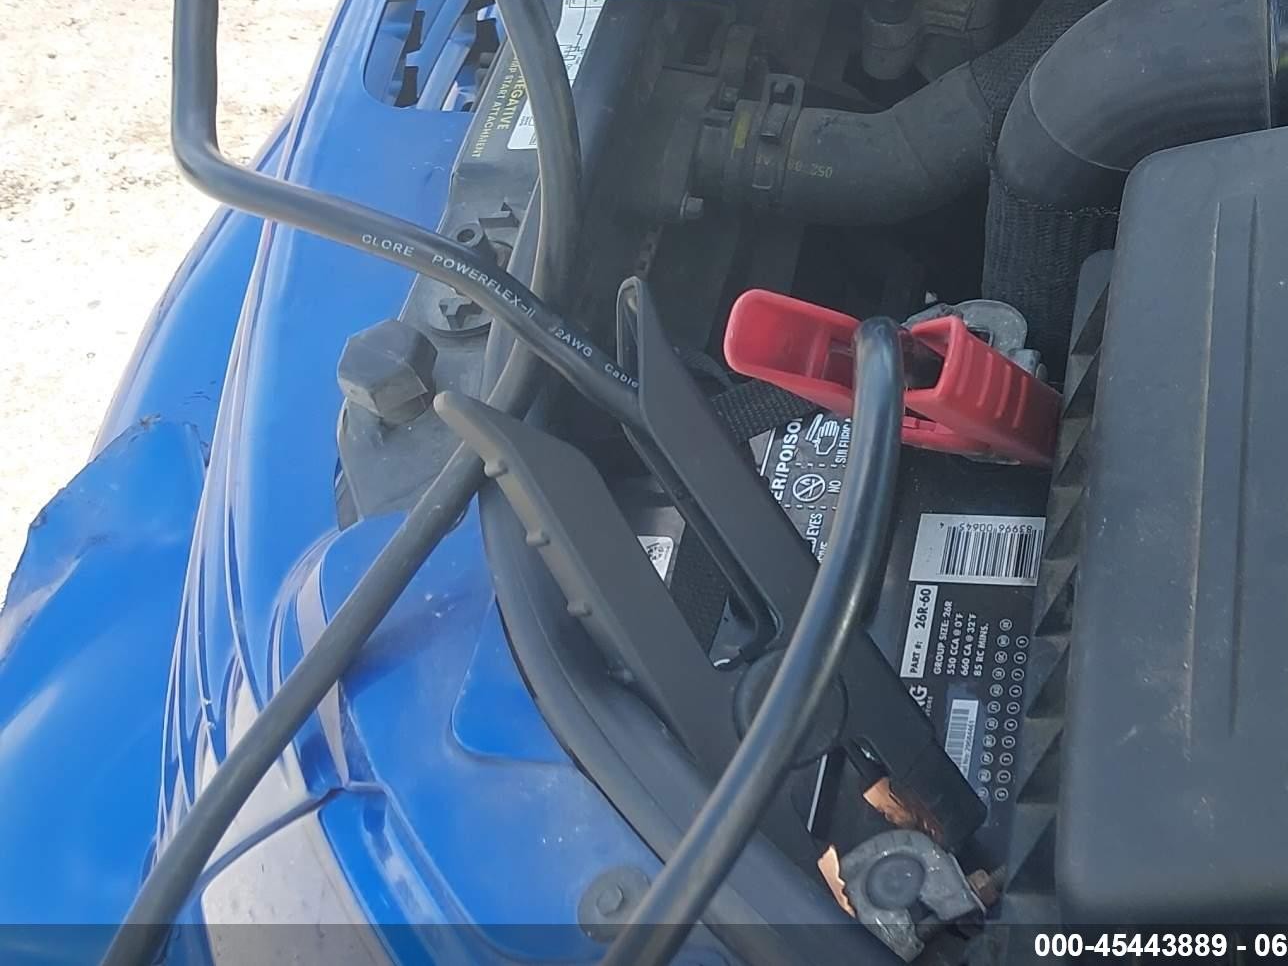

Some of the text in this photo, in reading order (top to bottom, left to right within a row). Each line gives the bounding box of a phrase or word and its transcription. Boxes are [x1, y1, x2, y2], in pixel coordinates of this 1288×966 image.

[361, 234, 416, 258] CLORE
[604, 363, 640, 389] Cable
[828, 480, 842, 493] NO
[806, 513, 823, 536] EYES
[914, 588, 932, 630] 26R-60
[933, 640, 946, 675] GROUP
[942, 600, 953, 618] 26R
[951, 637, 960, 656] CCA
[963, 641, 972, 656] CA
[910, 647, 921, 674] PART
[974, 623, 989, 677] 85 RC MINS.
[947, 656, 956, 675] 550
[960, 657, 969, 676] 660
